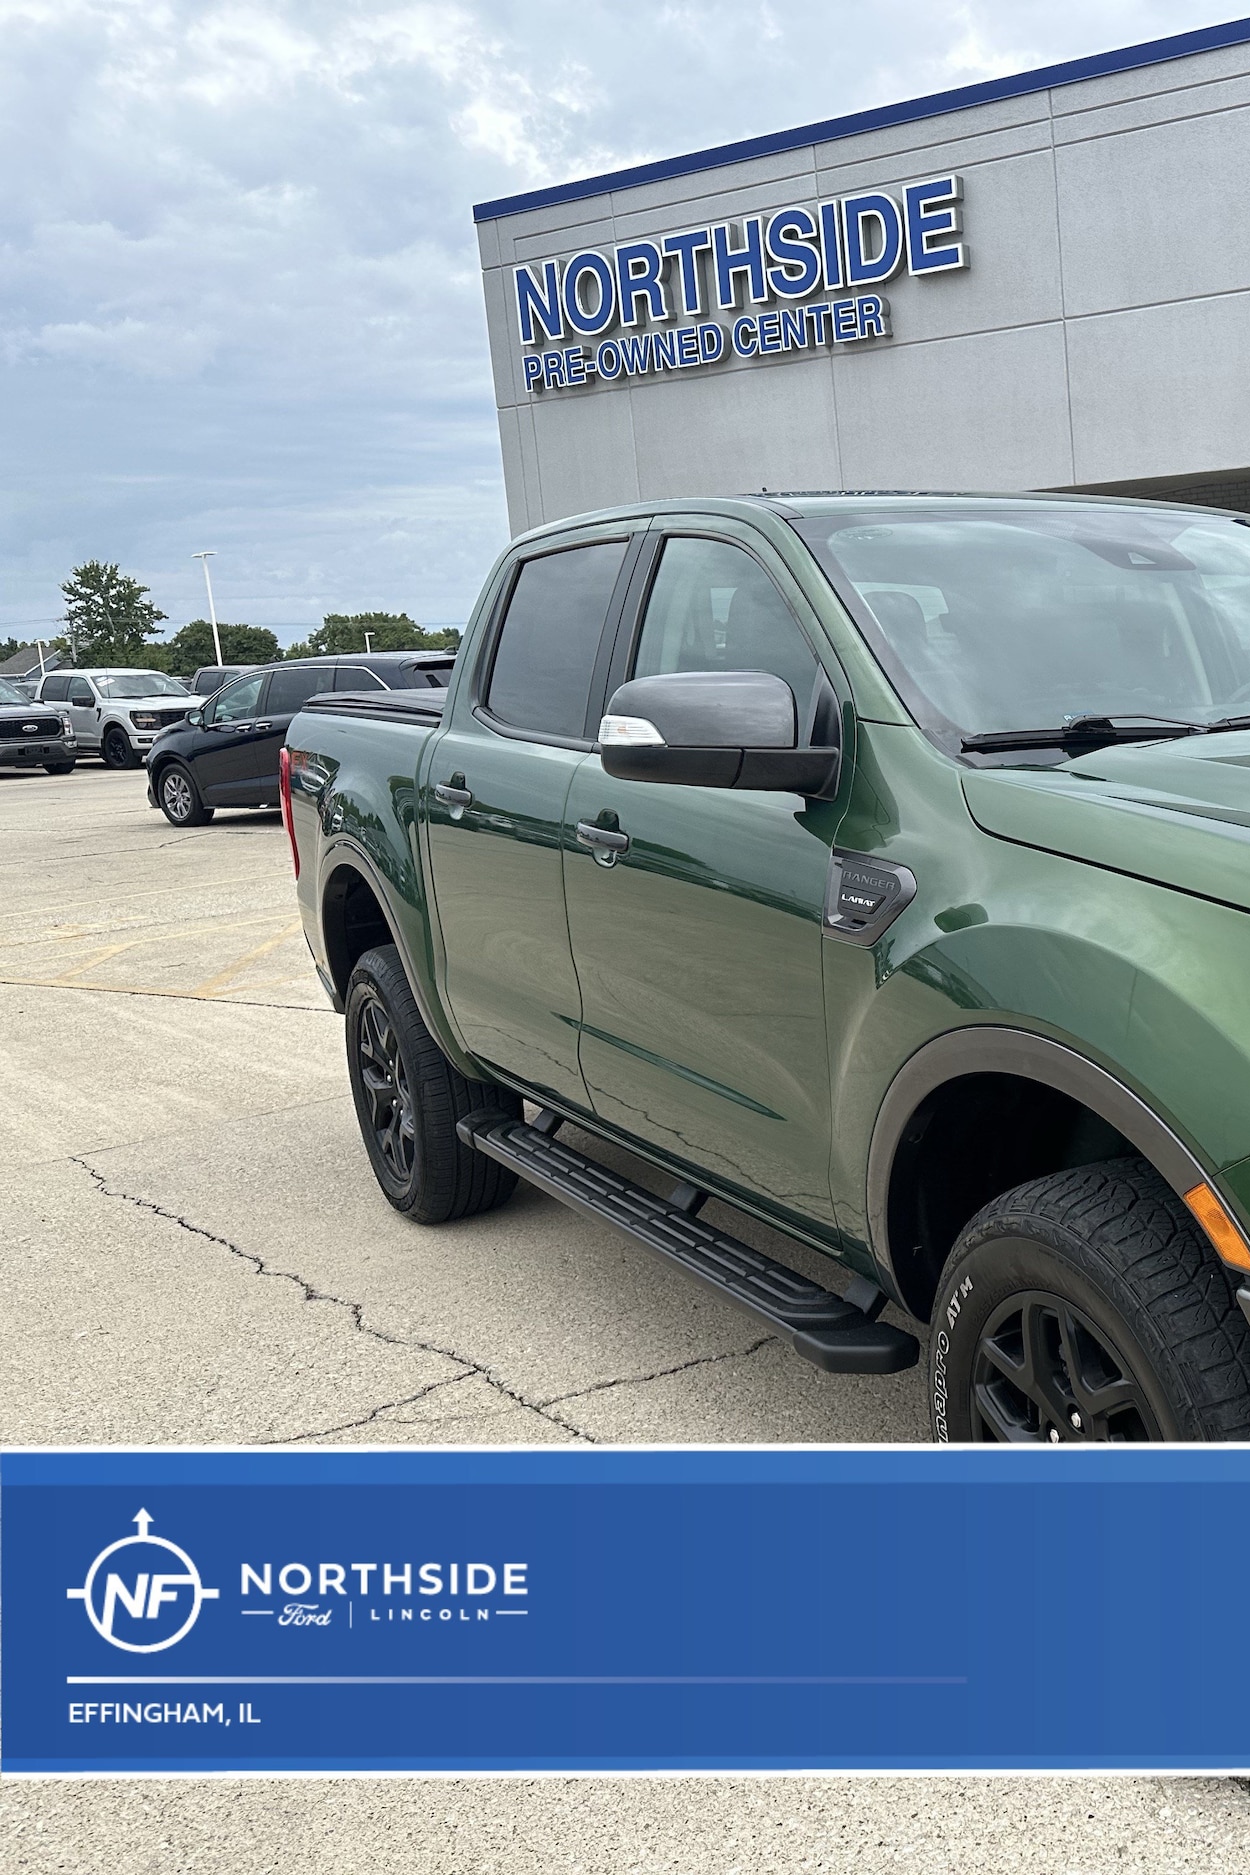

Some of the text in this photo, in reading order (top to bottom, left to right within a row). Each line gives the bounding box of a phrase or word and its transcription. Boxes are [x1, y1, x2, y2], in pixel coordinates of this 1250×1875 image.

[512, 174, 967, 347] NORTHSIDE
[522, 294, 889, 393] PRE-OWNED CENTER
[841, 893, 876, 907] LARIAT
[842, 870, 896, 891] RANGER
[934, 1331, 950, 1443] napro
